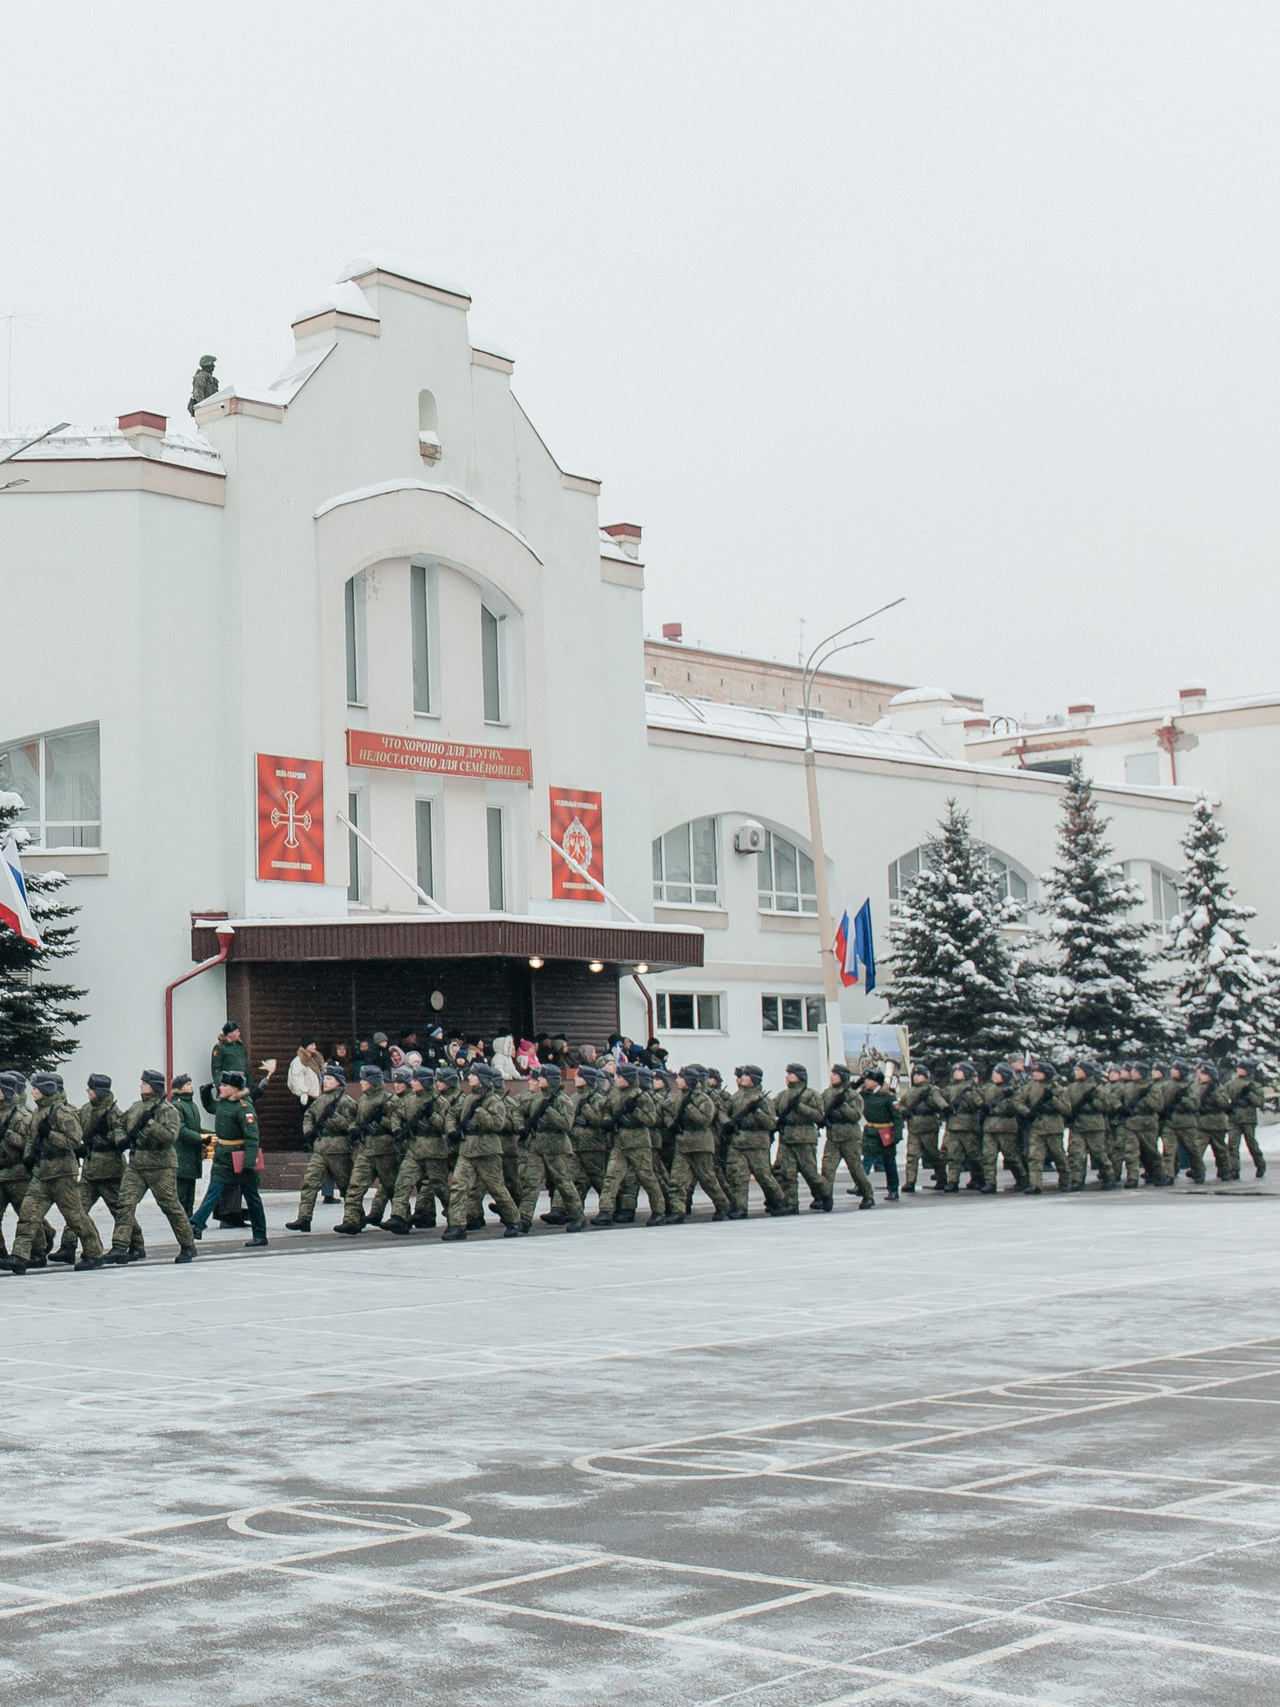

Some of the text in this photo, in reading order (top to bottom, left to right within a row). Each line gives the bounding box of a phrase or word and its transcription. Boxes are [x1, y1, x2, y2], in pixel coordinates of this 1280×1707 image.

[381, 736, 504, 761] ЧТО ХОРОШО ДЛЯ ДРУГИХ,
[359, 749, 524, 776] НЕДОСТАТОЧНО ДЛЯ СЕМЁНОВЦЕВ!
